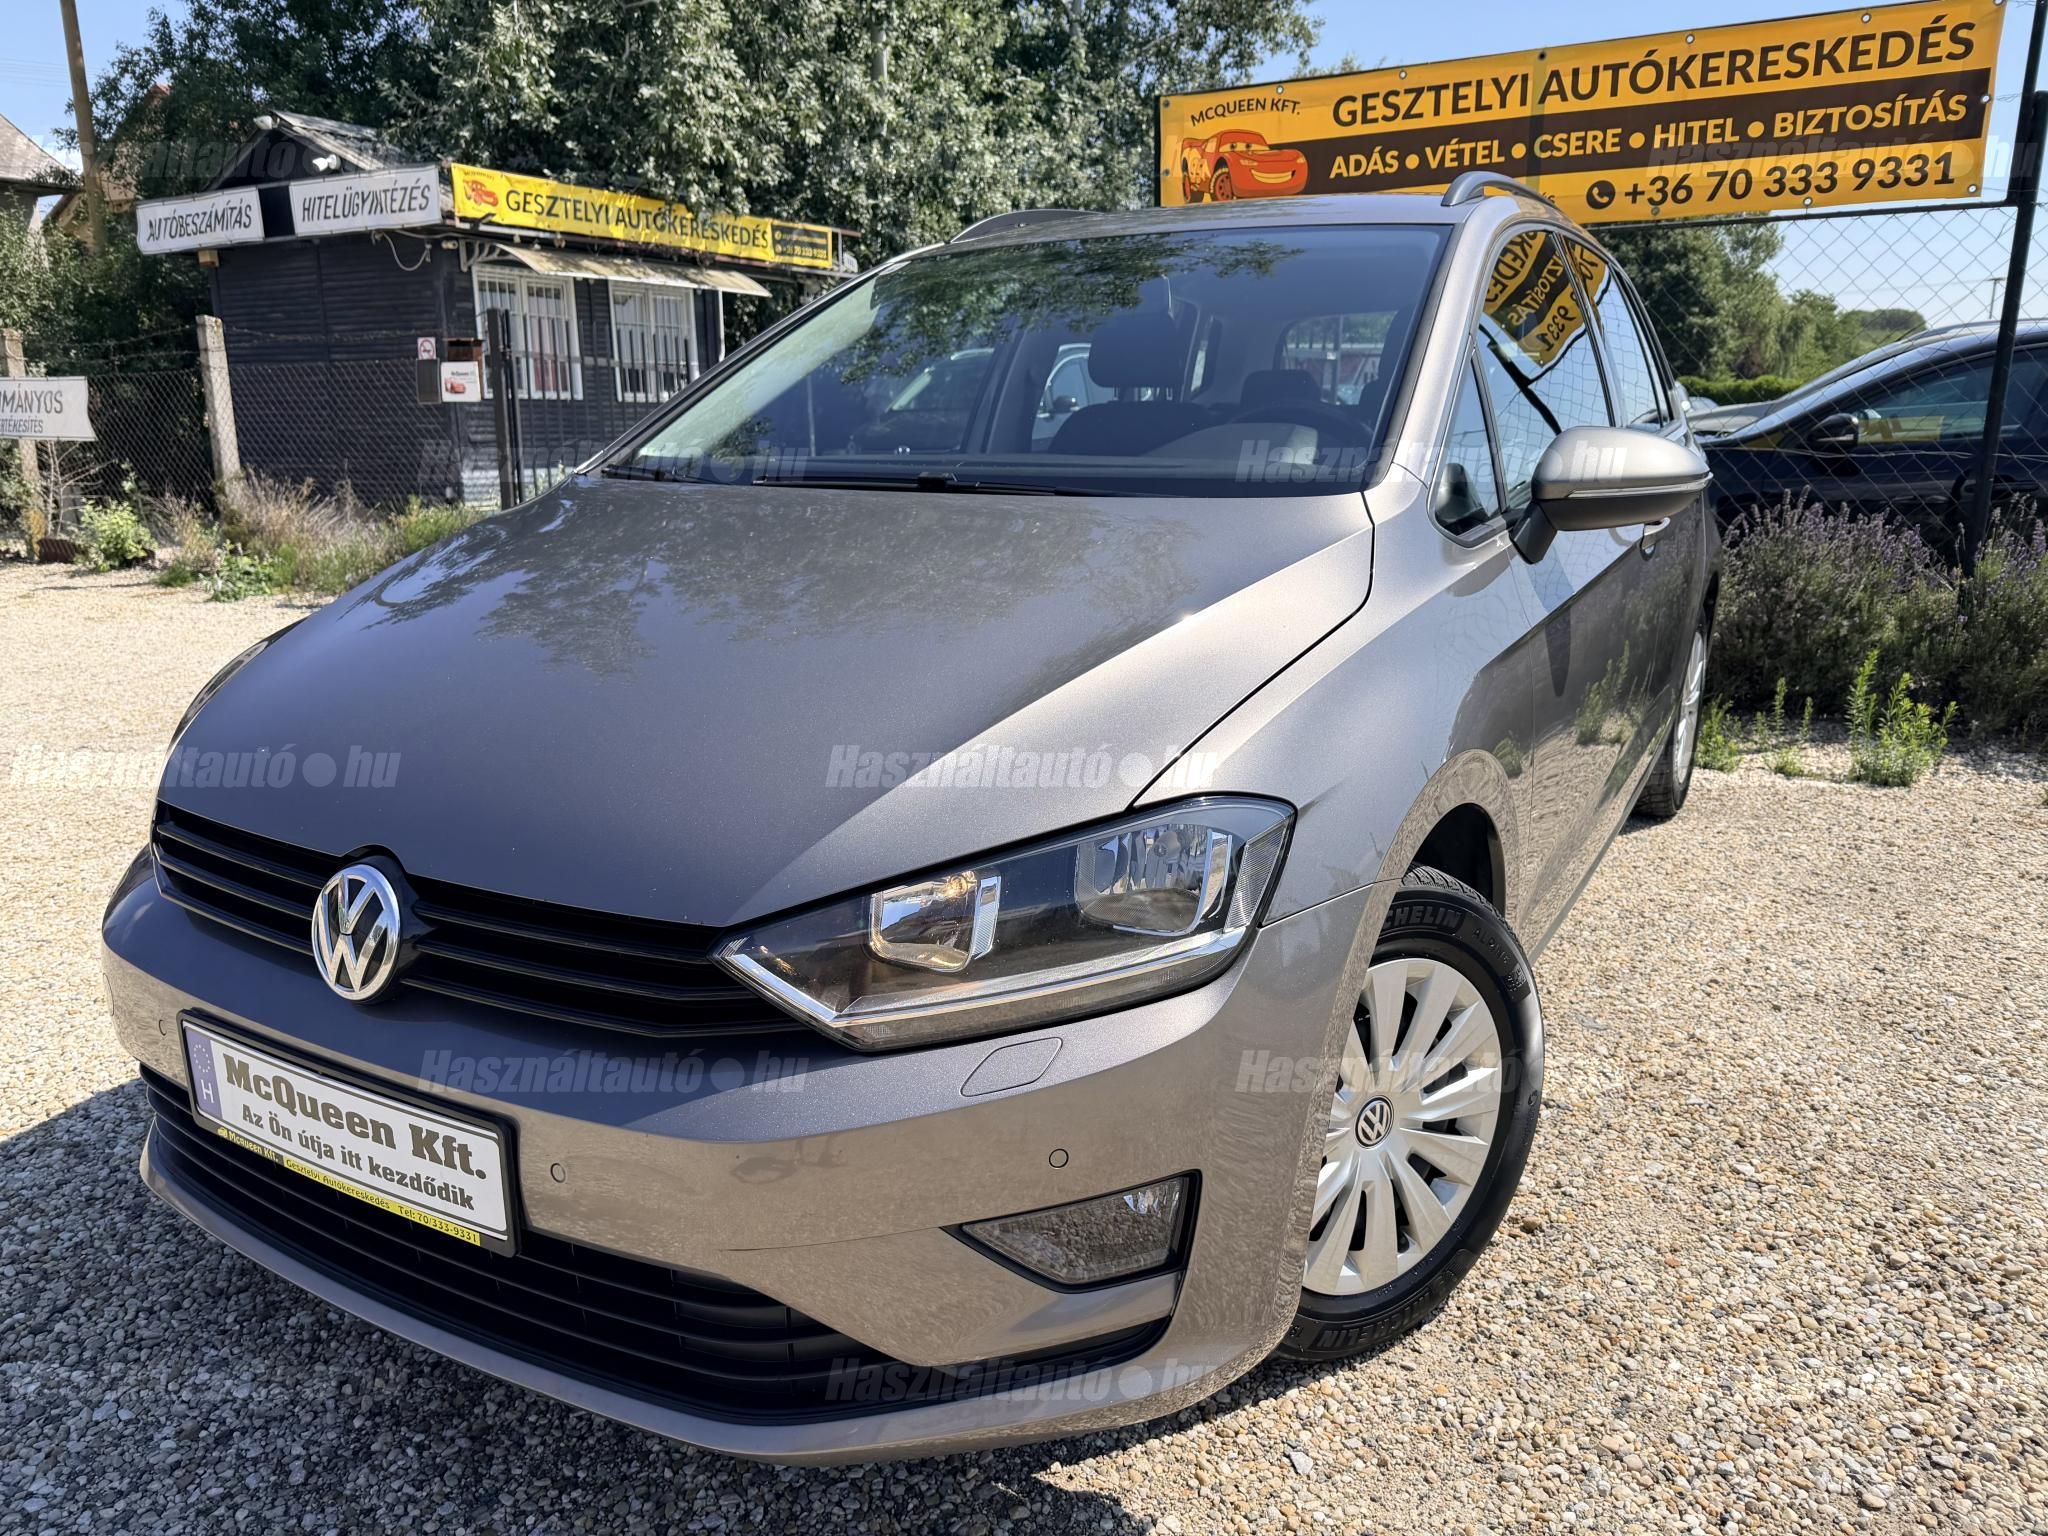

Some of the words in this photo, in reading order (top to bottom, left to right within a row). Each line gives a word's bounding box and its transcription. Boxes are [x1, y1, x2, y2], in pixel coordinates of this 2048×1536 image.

[1332, 73, 1530, 127] GESZTELYI
[1538, 14, 1976, 106] AUTÓKERESKEDÉS
[1190, 98, 1266, 127] MCQUEEN
[1270, 98, 1300, 115] KFT.
[1329, 145, 1399, 179] ADÁS
[1425, 134, 1505, 169] VÉTEL
[1534, 128, 1622, 159] CSERE
[1654, 118, 1740, 149] HITEL
[1773, 89, 1968, 139] BIZTOSÍTÁS
[302, 178, 431, 222] HITELÜGYINTÉZÉS
[1624, 174, 1693, 206] +36
[1706, 168, 1753, 202] 70
[1764, 161, 1838, 198] 333
[1853, 151, 1955, 191] 9331
[147, 198, 252, 242] AUTÓBESZÁMÍTÁS
[505, 189, 609, 223] GESZTELYI
[614, 203, 769, 249] AUTÓKERESKEDÉS
[0, 383, 63, 414] MÁNYOS
[0, 415, 44, 433] RTÉKESÍTÉS
[1383, 905, 1462, 930] CHELIN
[200, 1079, 214, 1104] H
[223, 1053, 396, 1150] McQueen
[408, 1123, 487, 1180] Kft.
[242, 1103, 264, 1129] Az
[268, 1110, 293, 1142] Ön
[298, 1129, 335, 1161] útja
[341, 1145, 362, 1171] itt
[368, 1155, 475, 1211] kezdődik
